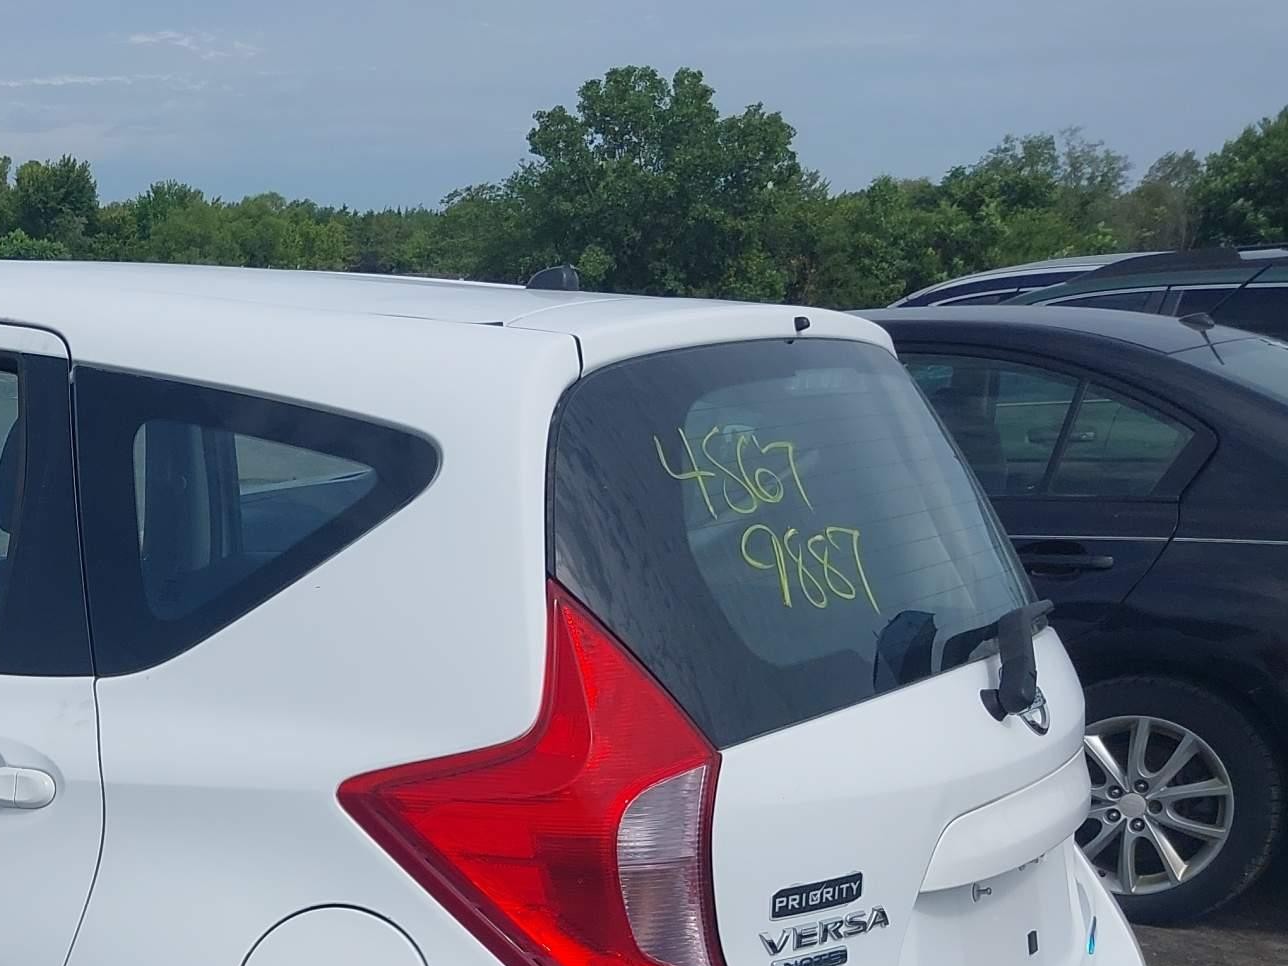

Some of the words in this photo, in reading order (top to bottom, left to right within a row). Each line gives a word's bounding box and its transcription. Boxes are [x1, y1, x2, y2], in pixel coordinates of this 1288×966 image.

[741, 524, 880, 615] 9887
[774, 881, 861, 912] PRIORITY
[759, 905, 889, 956] VERSA
